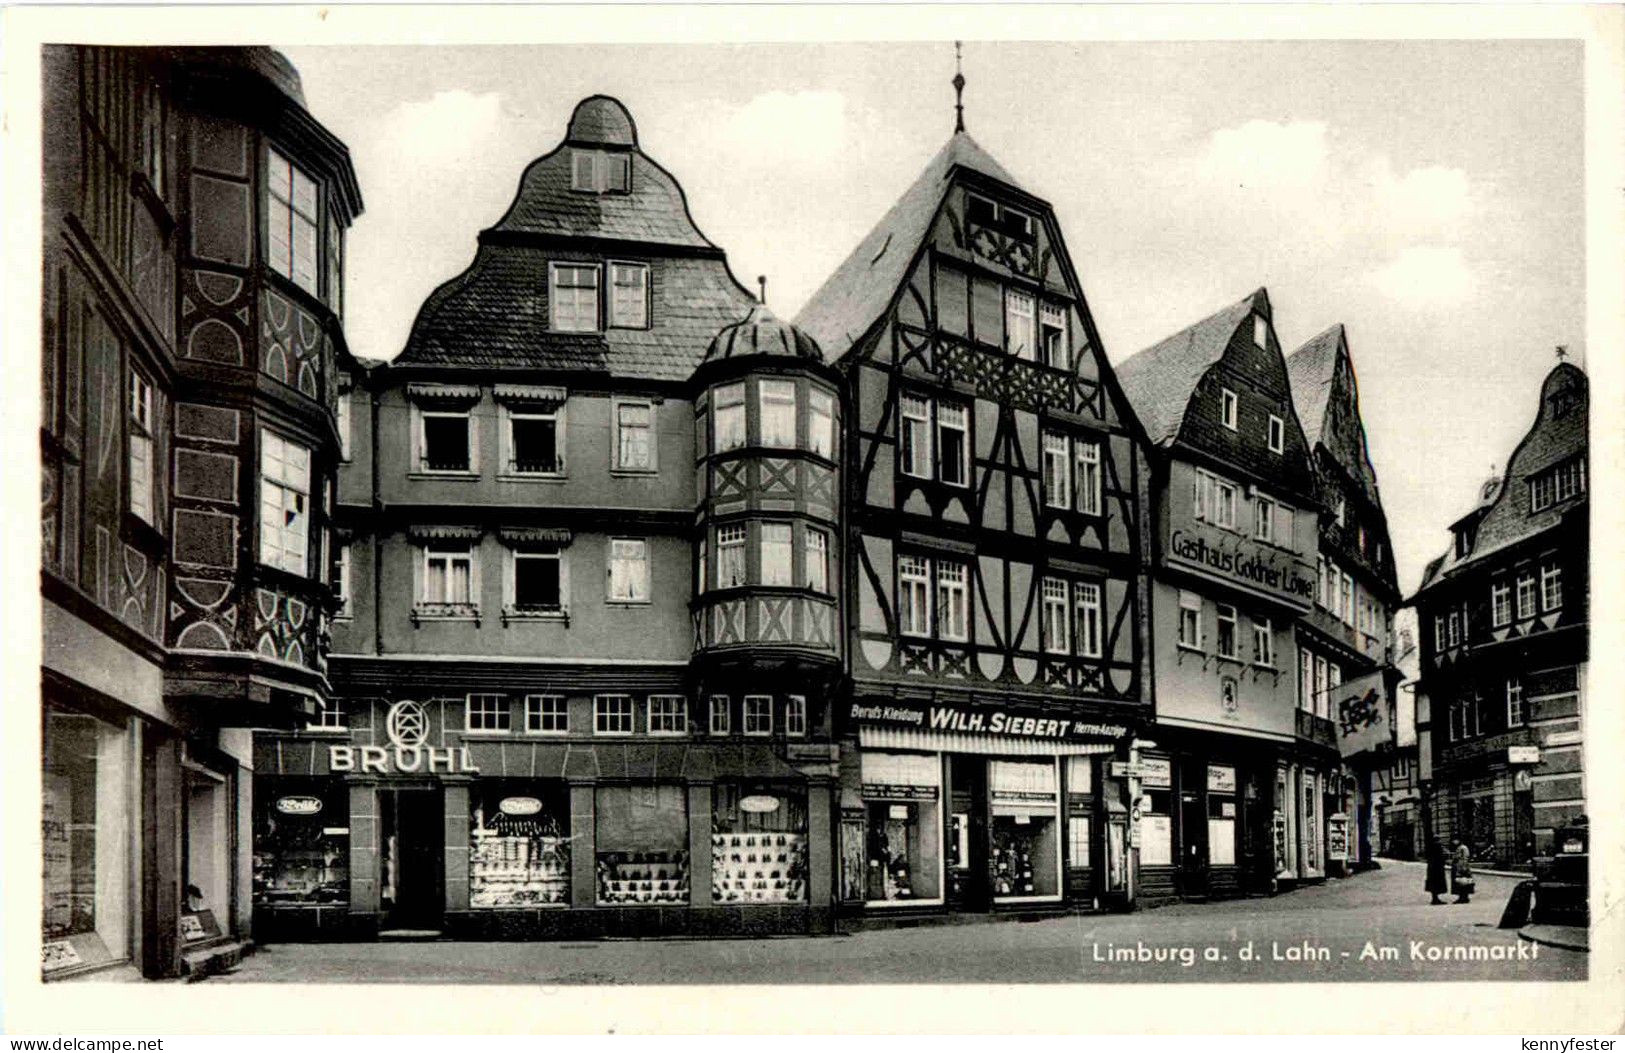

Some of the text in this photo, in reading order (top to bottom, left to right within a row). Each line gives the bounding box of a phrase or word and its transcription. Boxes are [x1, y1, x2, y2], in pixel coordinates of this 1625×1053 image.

[1172, 530, 1233, 572] Gasthaus
[929, 707, 1071, 737] WILH. SIEBERT
